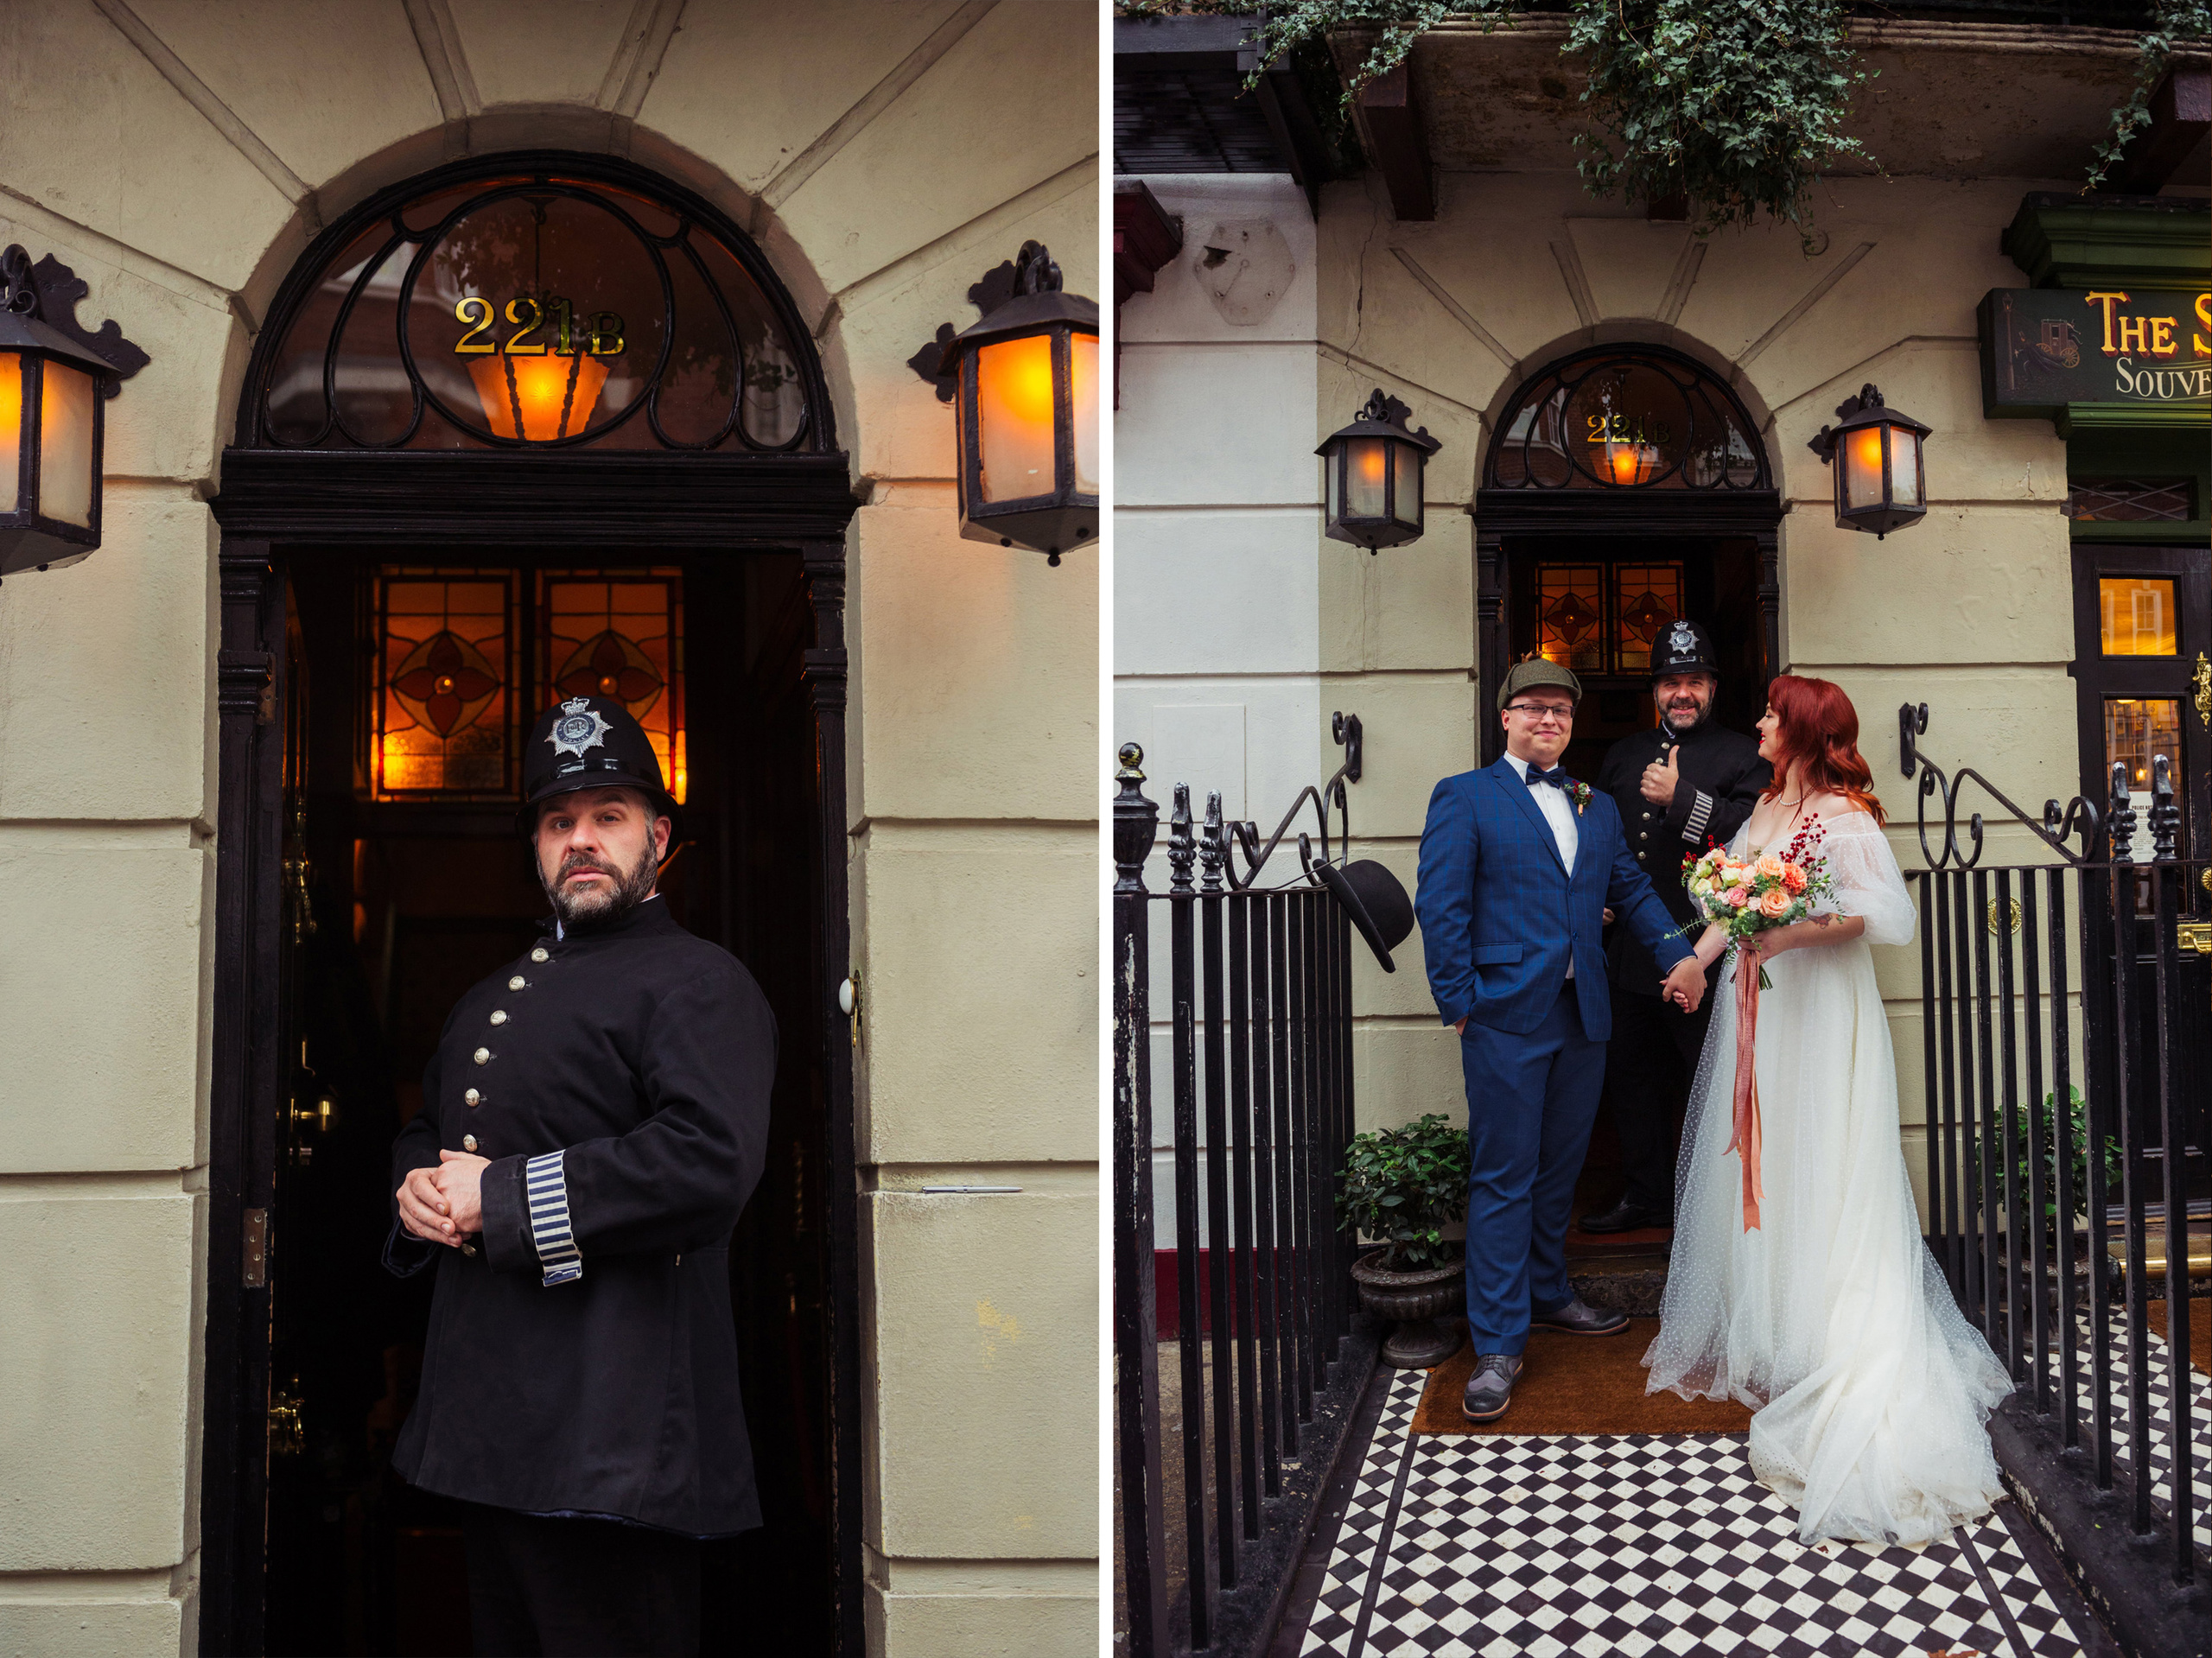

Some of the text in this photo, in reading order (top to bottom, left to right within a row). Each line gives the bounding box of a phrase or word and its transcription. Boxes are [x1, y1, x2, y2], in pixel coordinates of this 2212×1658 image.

[454, 296, 626, 356] 221B
[2084, 290, 2178, 358] THE
[1586, 414, 1670, 443] 221B
